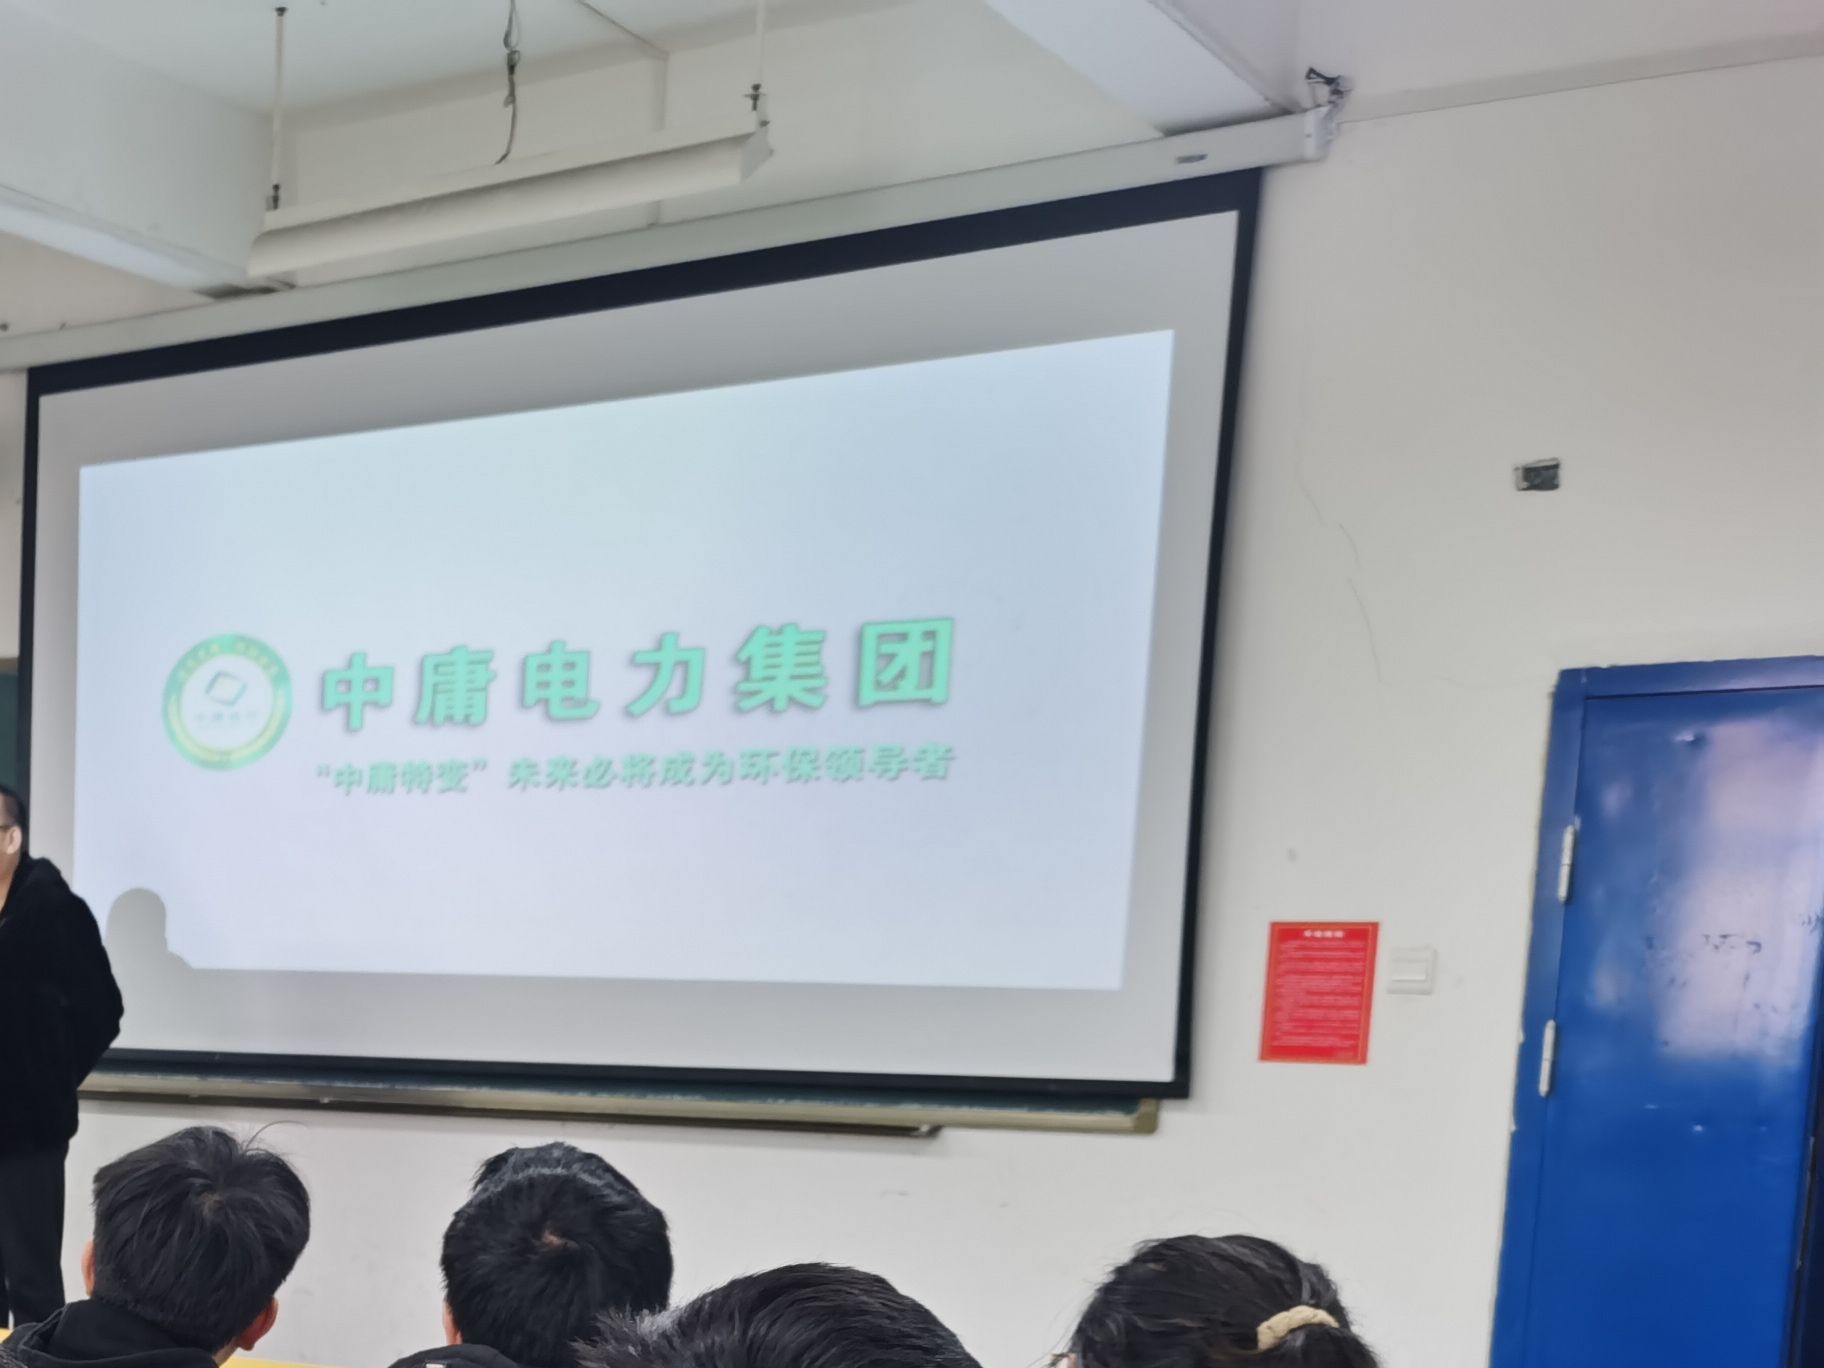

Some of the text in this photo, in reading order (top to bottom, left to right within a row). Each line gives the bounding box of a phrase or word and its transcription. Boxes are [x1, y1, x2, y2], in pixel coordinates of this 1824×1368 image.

[320, 617, 955, 732] 中庸电力集团
